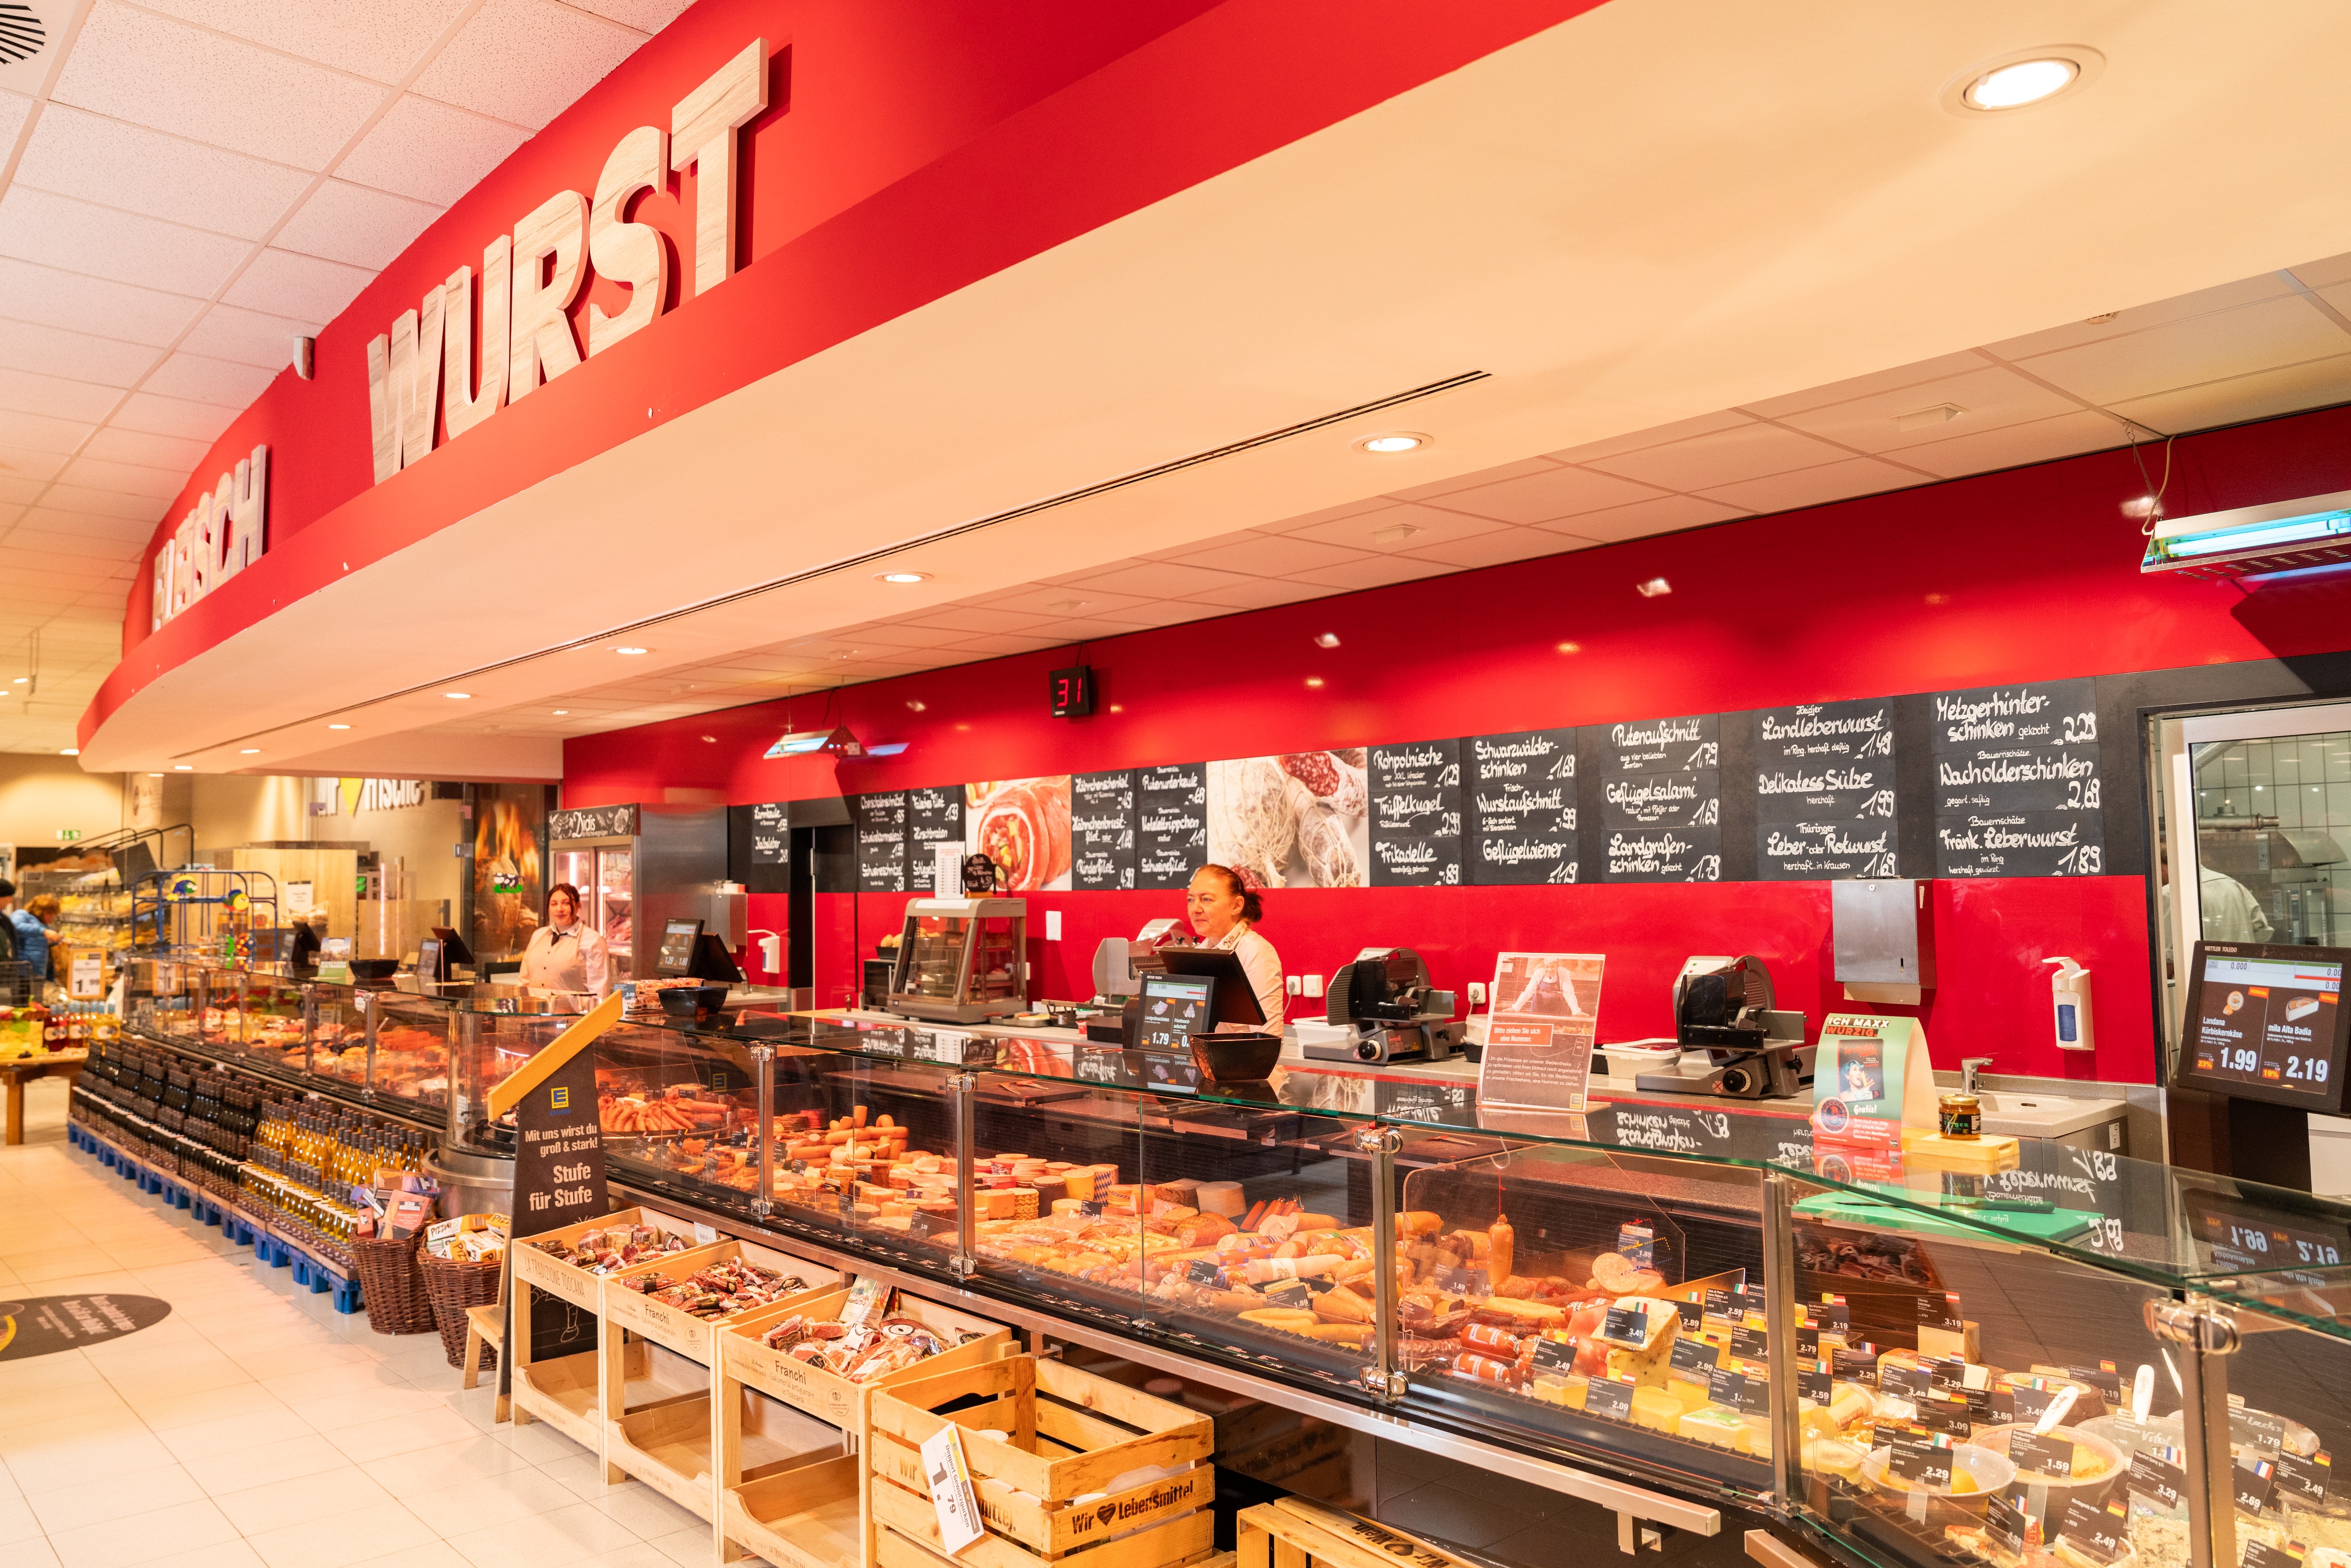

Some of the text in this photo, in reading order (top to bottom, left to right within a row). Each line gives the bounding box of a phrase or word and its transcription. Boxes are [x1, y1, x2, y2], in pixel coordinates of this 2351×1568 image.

[367, 37, 768, 485] WURST
[1057, 678, 1081, 706] 31
[1763, 709, 1884, 740] Landleberwurst
[1948, 718, 2051, 742] schinken gekocht
[1612, 718, 1702, 752] Putenaufschnitt
[1373, 745, 1443, 773] Rohpolnische
[1977, 749, 2031, 759] Bauernschätze
[1481, 759, 1527, 779] schinken
[1940, 752, 2093, 786] Wacholderschinken
[1759, 767, 1874, 794] Delikatess Sülze
[1504, 783, 1524, 792] Frisch-
[1607, 776, 1698, 811] Geflügelsalami
[1373, 792, 1445, 821] Trüffelkugel
[1476, 788, 1564, 818] Wurstaufschnitt
[1806, 795, 1835, 807] herzhaft
[1968, 816, 2026, 827] Bauernschätze
[1796, 823, 1836, 835] Thüringer
[1940, 823, 2079, 851] Fränk. Leberwurst
[1375, 842, 1438, 864] Frikadelle
[1483, 838, 1567, 866] Geflügelwiener
[1609, 833, 1693, 862] Landgrafen-
[1609, 856, 1682, 875] schinken gekocht
[1981, 853, 2004, 865] im Ring
[1949, 866, 2000, 876] herzhaft gewürzt
[1828, 1017, 1890, 1028] ICH MAXX
[2203, 1016, 2225, 1026] Landana
[1825, 1025, 1878, 1037] WÜRZIG.
[2201, 1026, 2242, 1039] Kürbiskernkäse
[2268, 1024, 2312, 1036] mila Alta Badia
[1152, 1032, 1169, 1045] 1.79
[2198, 1060, 2212, 1068] 23%
[2221, 1047, 2256, 1072] 1.99
[2286, 1056, 2327, 1082] 2.19
[1854, 1104, 1877, 1115] Gratis!
[525, 1123, 597, 1142] Mit uns wirst du
[540, 1137, 598, 1157] groß & stark!
[553, 1162, 591, 1184] Stufe
[529, 1185, 592, 1211] für Stufe
[525, 1255, 585, 1298] LA TRADIZIONE TOSCANA
[1294, 1299, 1308, 1308] 1.89
[645, 1304, 670, 1324] Franchi
[1728, 1307, 1743, 1316] 2.59
[1683, 1318, 1699, 1327] 2.89
[1833, 1321, 1848, 1330] 2.19
[1945, 1318, 1961, 1327] 3.19
[1629, 1328, 1643, 1337] 3.49
[732, 1358, 766, 1377] CONSORZIO TOSCANO
[1555, 1360, 1570, 1370] 2.49
[1697, 1361, 1713, 1371] 2.99
[775, 1360, 806, 1385] Franchi
[1859, 1370, 1876, 1379] 2.29
[770, 1372, 815, 1399] Salumeria artigianale
[1944, 1379, 1961, 1388] 2.29
[788, 1388, 804, 1403] Toscana
[1812, 1390, 1829, 1399] 2.59
[1612, 1401, 1629, 1411] 2.09
[1992, 1410, 2012, 1421] 3.69
[1949, 1420, 1968, 1431] 3.09
[2114, 1424, 2140, 1434] hausgemacht
[2115, 1419, 2135, 1428] Frischkäse
[2247, 1416, 2283, 1433] Lachs
[2012, 1435, 2030, 1443] Pfefferoni
[2013, 1430, 2037, 1439] Brotaufstrich
[2257, 1434, 2280, 1446] 1.79
[1893, 1438, 1931, 1450] Scamorza affumicata
[899, 1458, 917, 1481] Wir
[2047, 1458, 2069, 1471] 1.59
[1925, 1466, 1949, 1479] 2.29
[946, 1444, 970, 1528] Deppert Gewürzgurken
[2158, 1484, 2177, 1499] 3.29
[2304, 1481, 2323, 1495] 2.49
[2241, 1492, 2260, 1507] 2.69
[1072, 1480, 1196, 1535] Wir Lebensmittel.
[2094, 1532, 2115, 1548] 2.49
